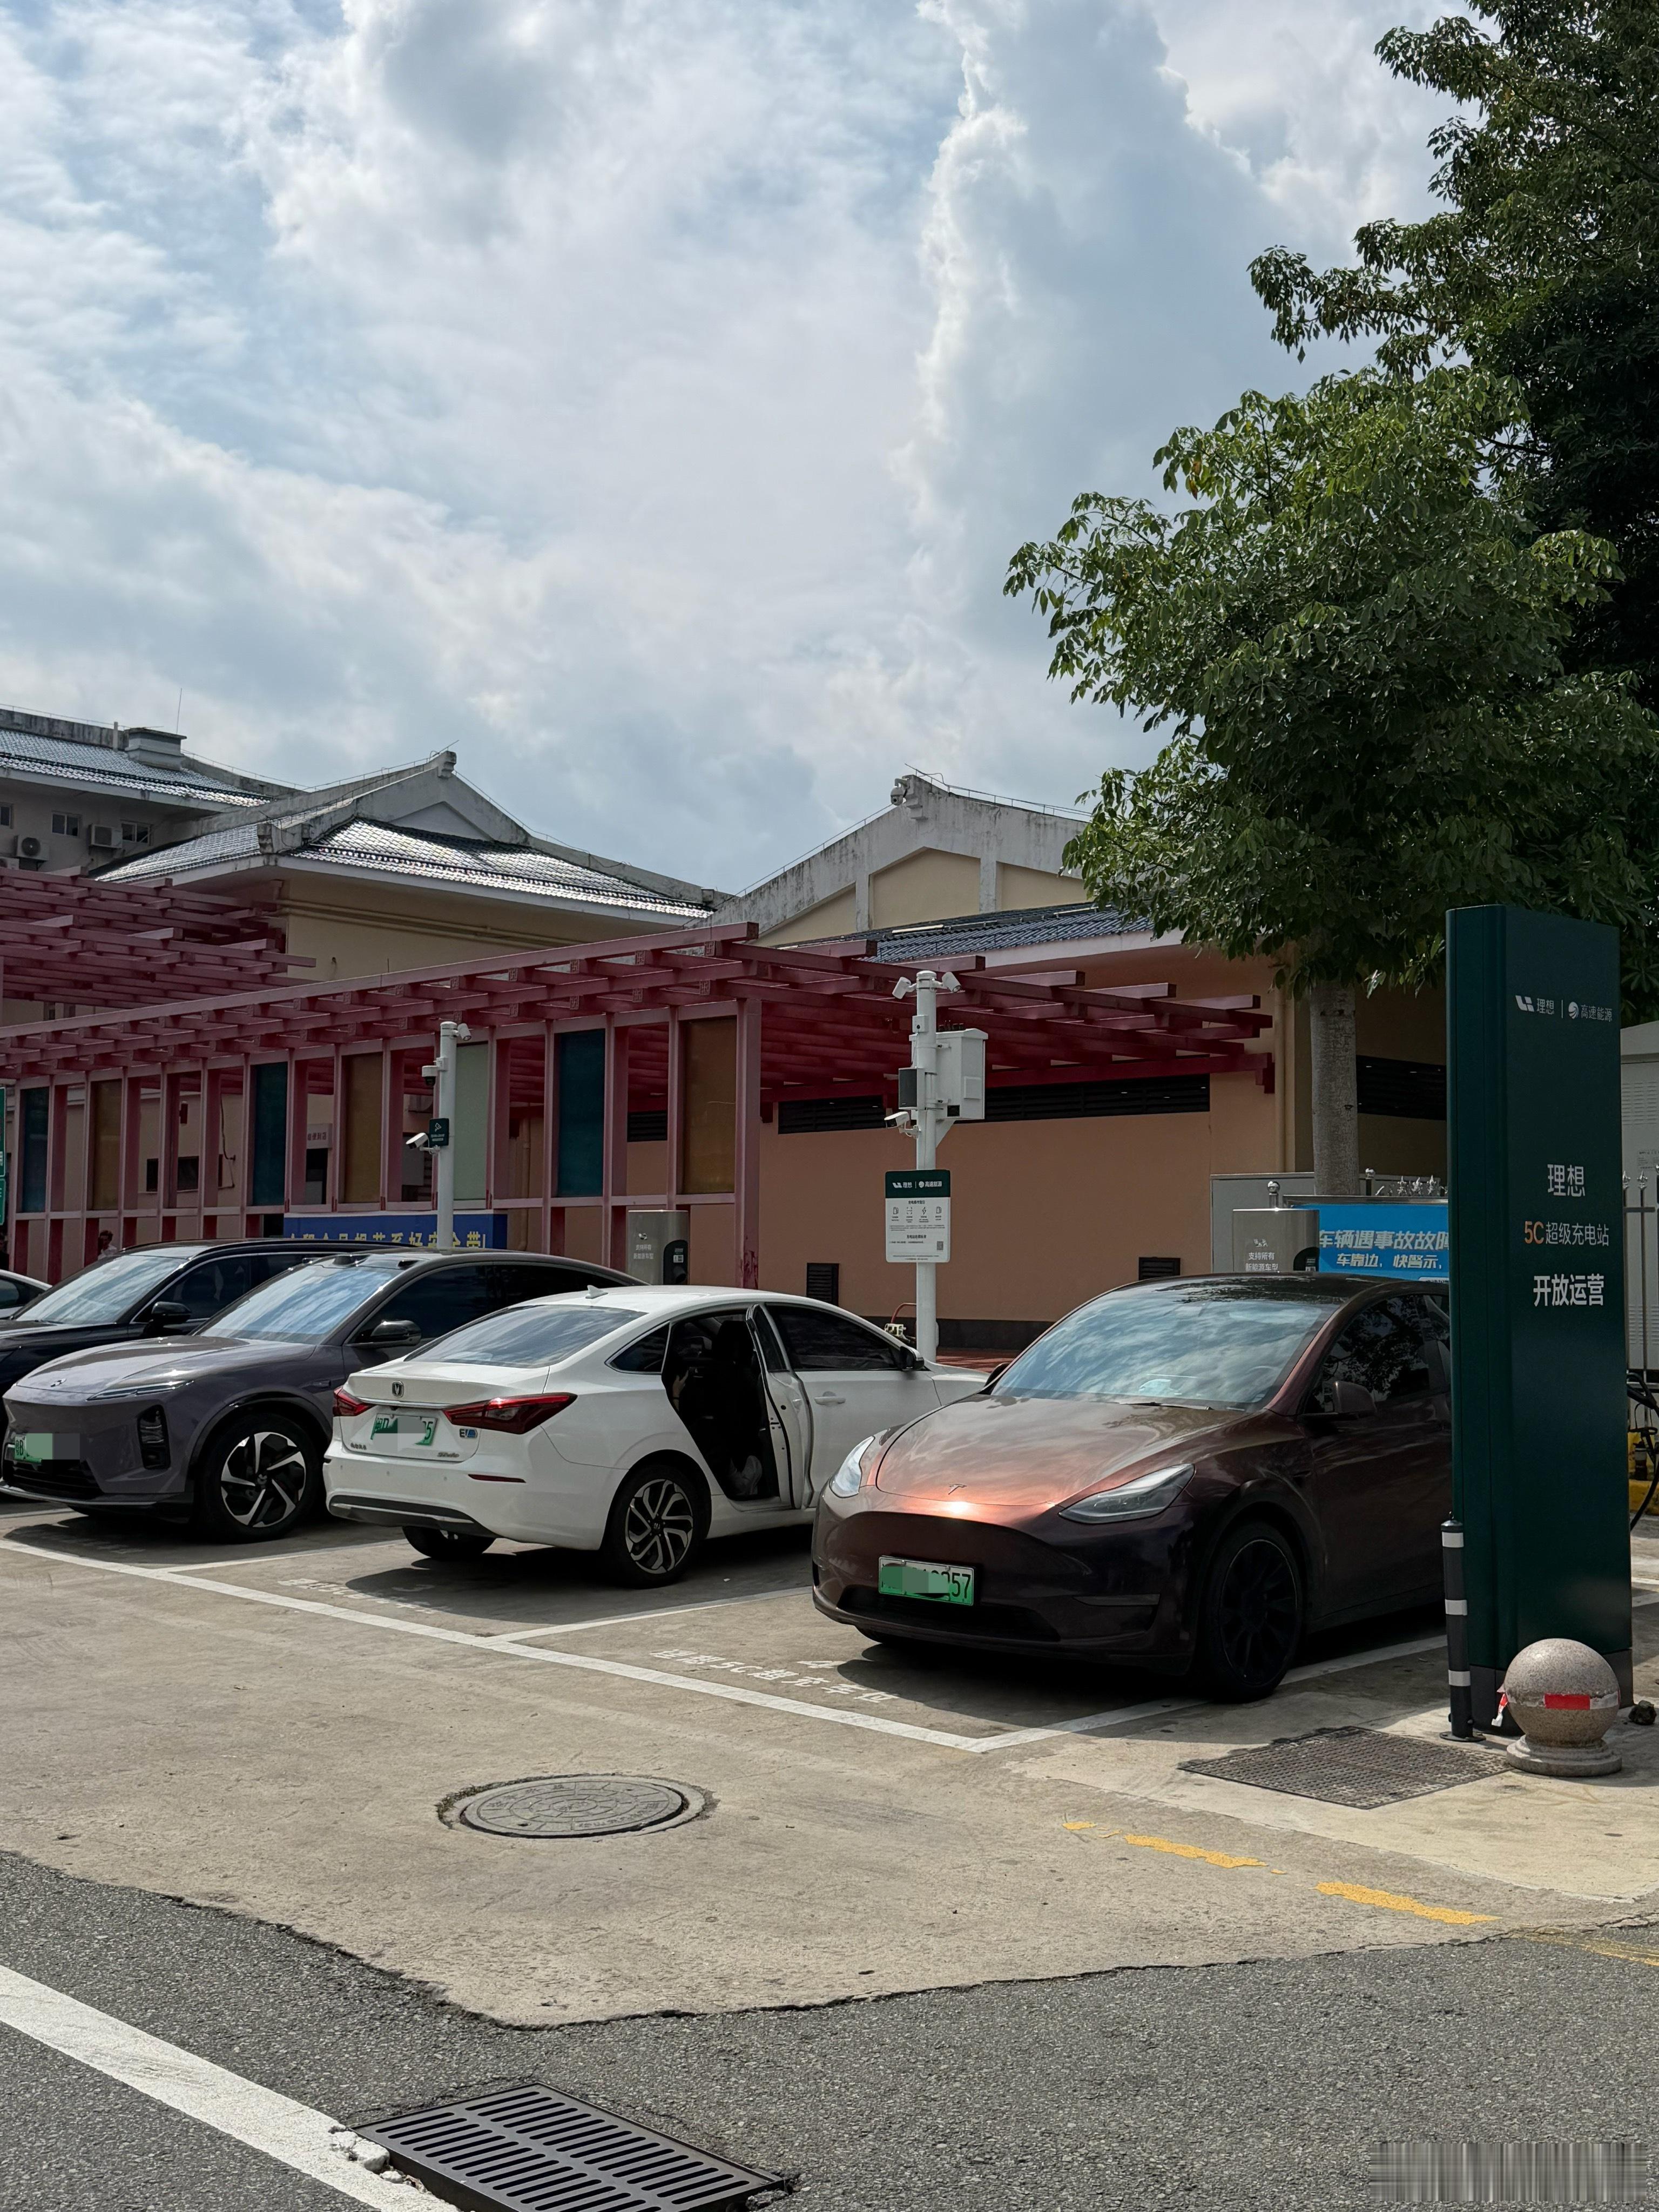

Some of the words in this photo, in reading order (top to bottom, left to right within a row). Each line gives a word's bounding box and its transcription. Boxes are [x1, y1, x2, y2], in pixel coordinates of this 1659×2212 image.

[1537, 998, 1555, 1015] 理想
[1581, 1004, 1613, 1022] 高速能源
[1547, 1164, 1586, 1197] 理想
[1525, 1220, 1609, 1247] 5C超级充电站
[1249, 1252, 1275, 1260] 支持所有
[1533, 1273, 1604, 1307] 开放运营
